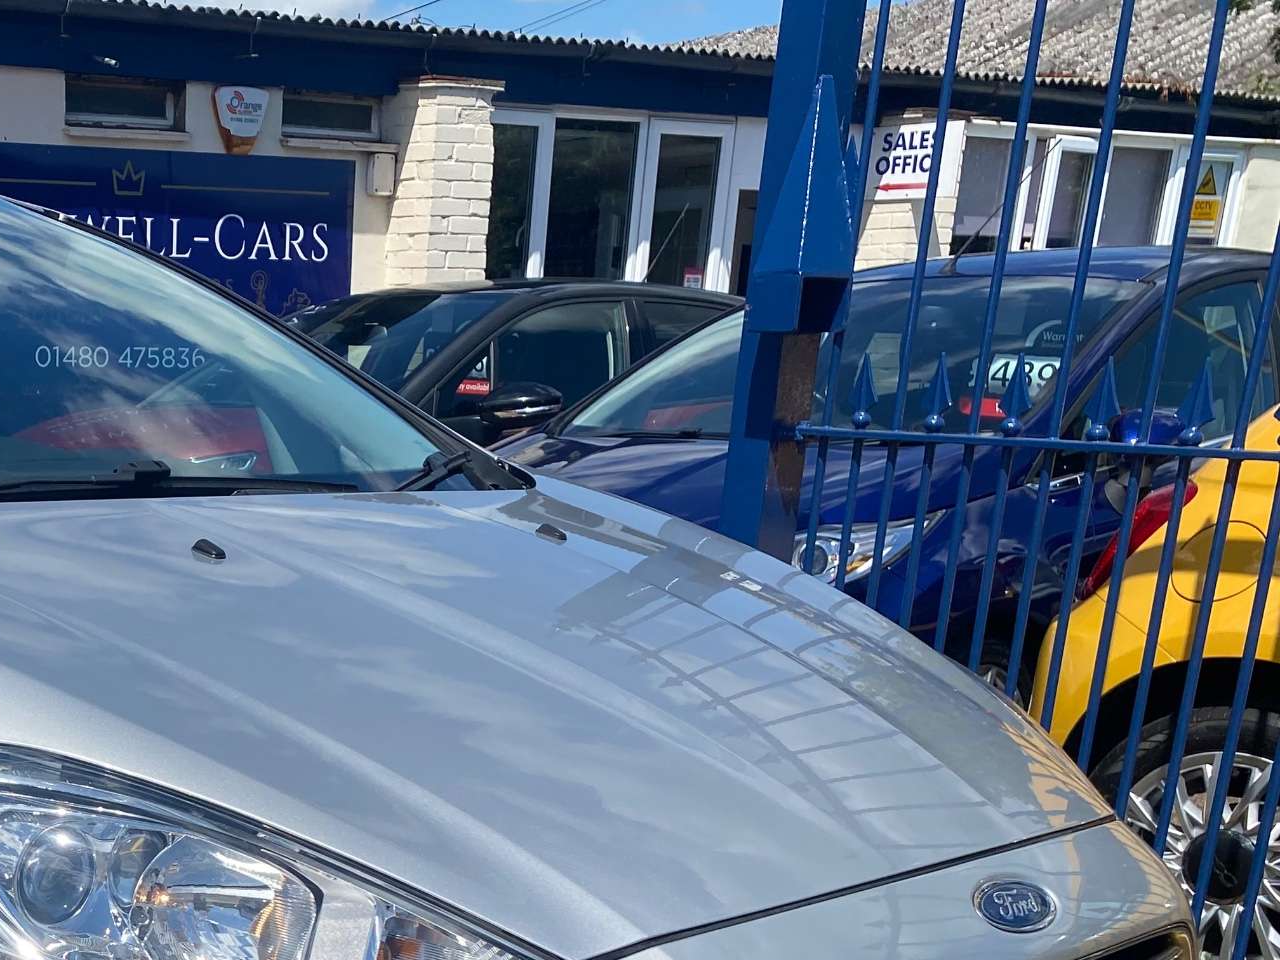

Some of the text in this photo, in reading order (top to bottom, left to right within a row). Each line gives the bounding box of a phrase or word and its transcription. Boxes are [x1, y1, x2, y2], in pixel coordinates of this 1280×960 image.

[875, 154, 932, 175] OFFIC
[35, 345, 205, 369] 01480 475836
[993, 889, 1040, 919] Ford
